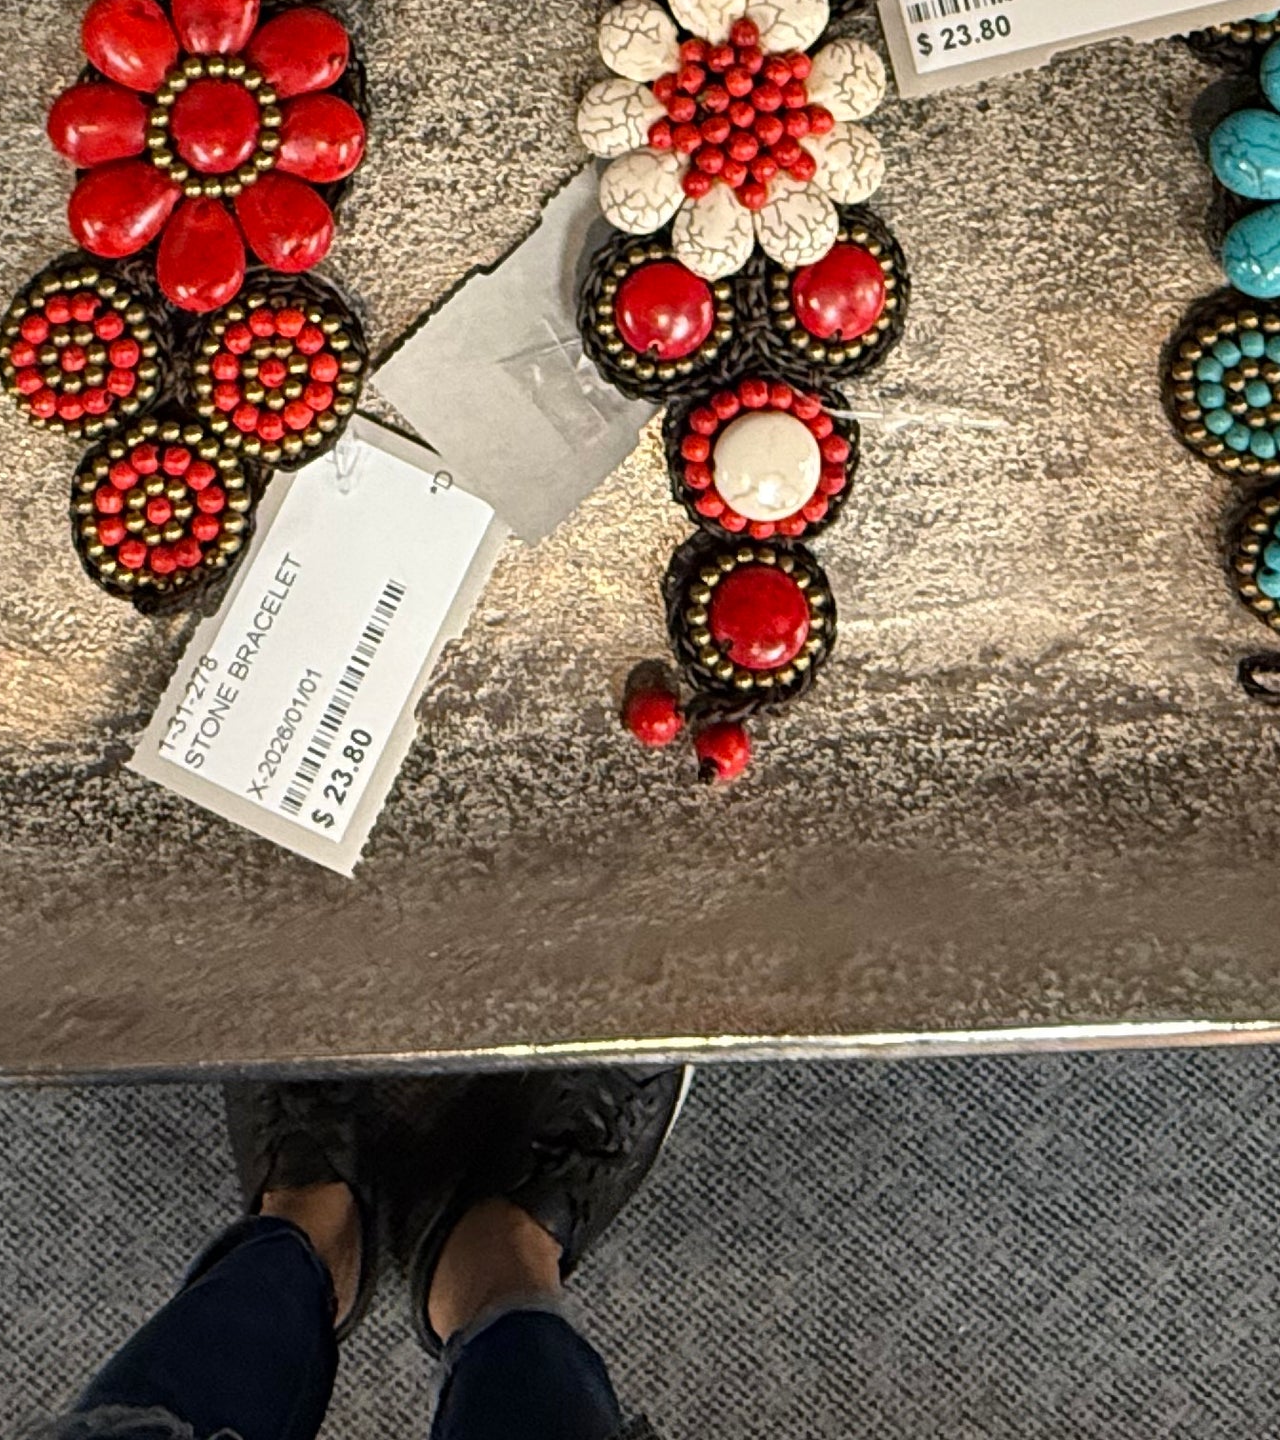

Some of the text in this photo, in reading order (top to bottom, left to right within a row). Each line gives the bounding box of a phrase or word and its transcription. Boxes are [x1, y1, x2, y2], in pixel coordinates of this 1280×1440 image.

[917, 14, 1012, 57] $ 23.80
[159, 654, 218, 751] 1-31-278
[184, 552, 302, 770] STONE BRACELET
[246, 667, 323, 801] X-2026/01/01
[311, 727, 373, 829] $ 23.80
